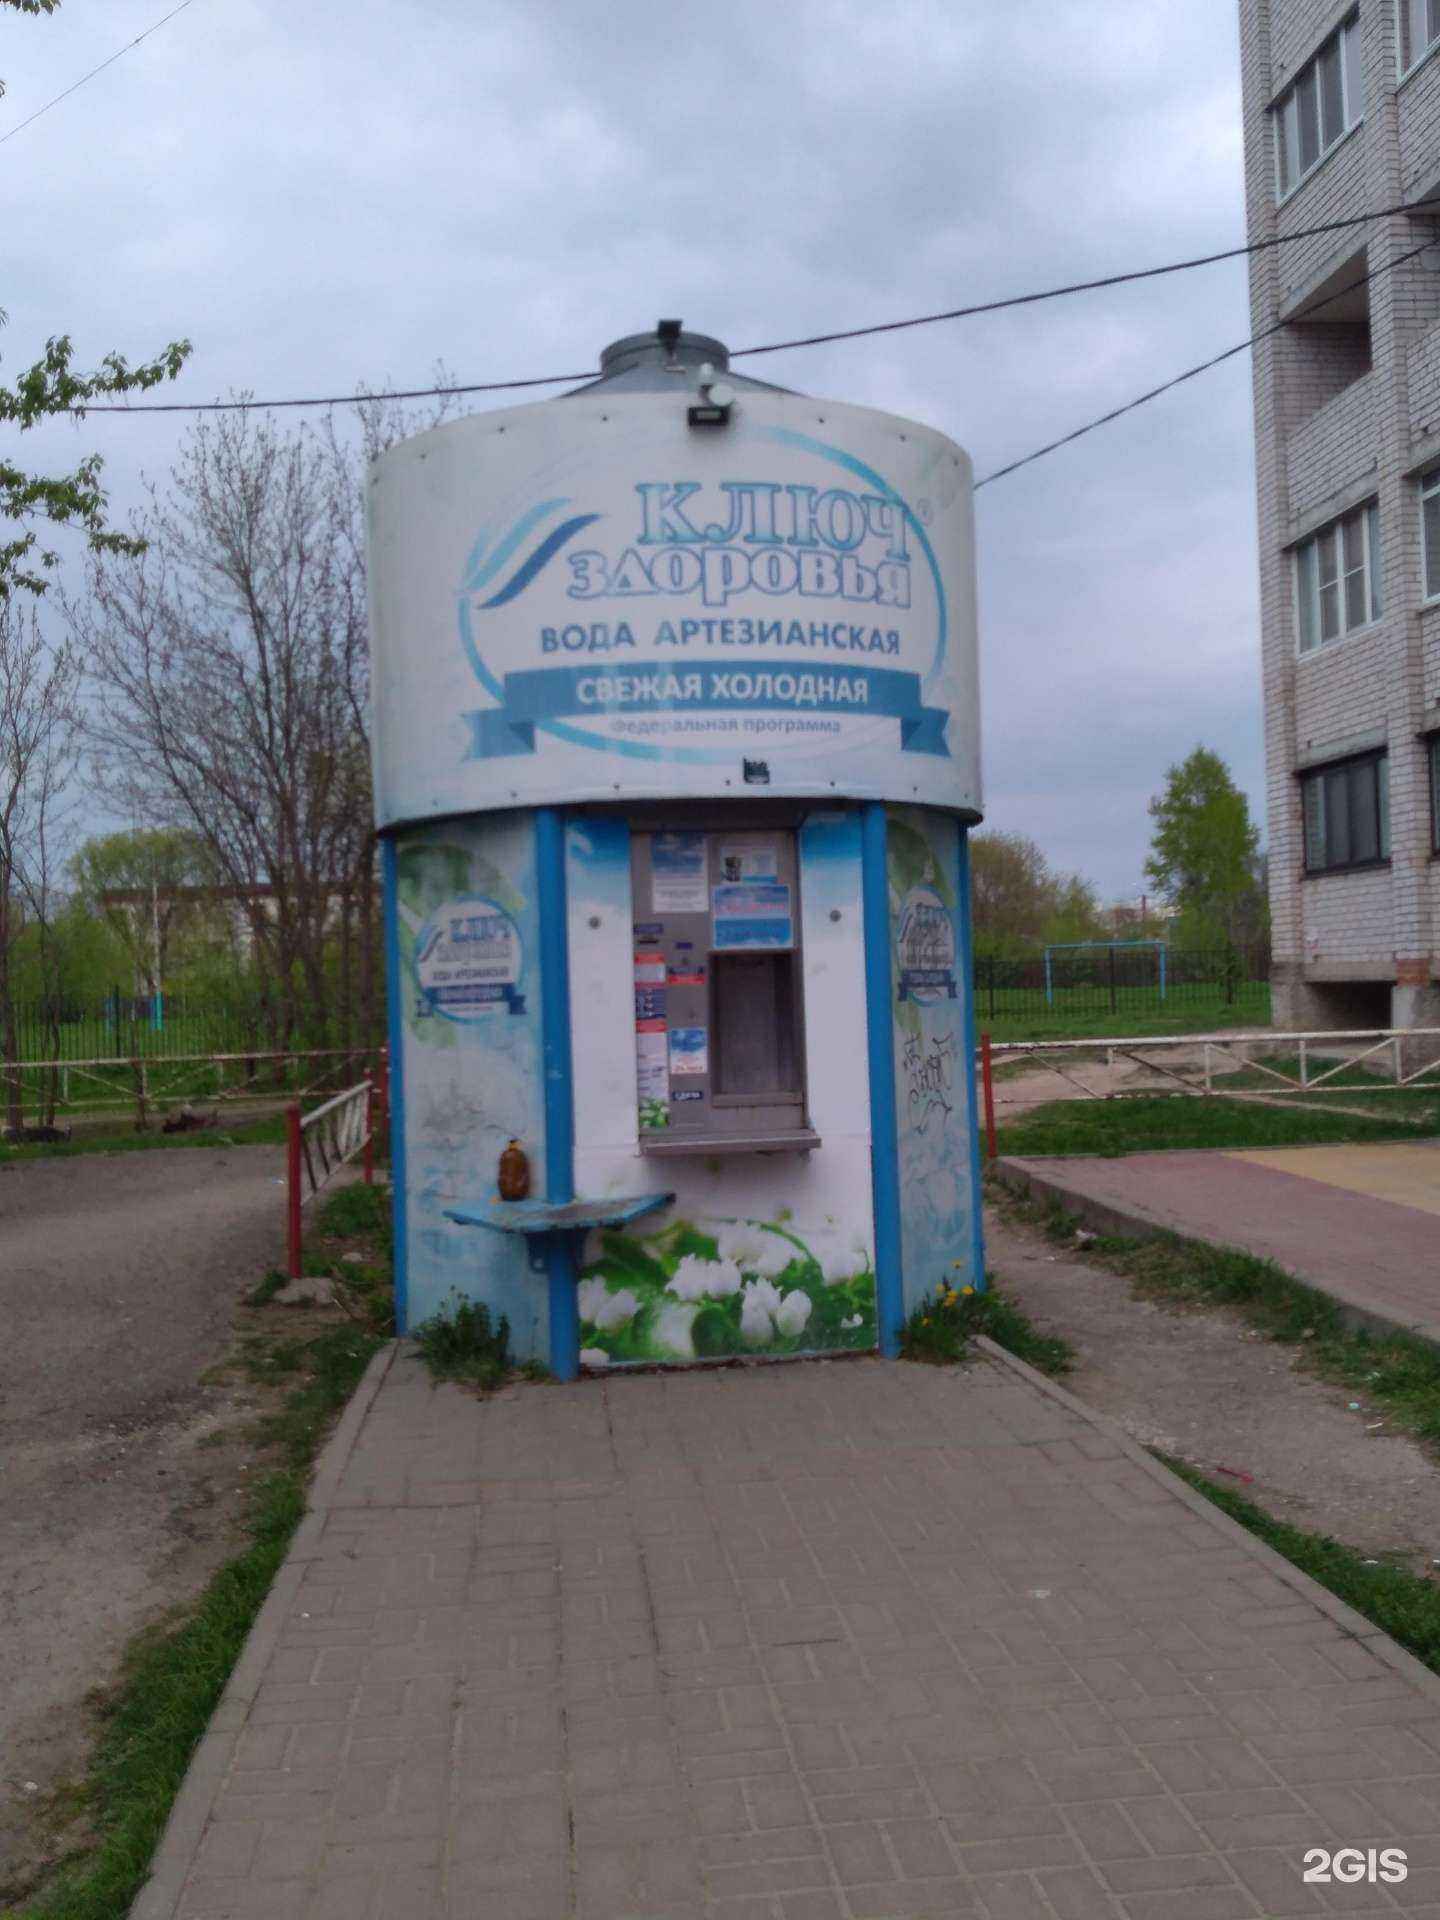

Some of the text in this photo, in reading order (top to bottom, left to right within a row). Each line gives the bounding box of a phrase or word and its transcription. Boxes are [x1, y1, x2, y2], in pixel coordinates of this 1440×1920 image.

[635, 481, 910, 562] КЛЮЧ
[541, 618, 900, 655] ВОДА АРТЕЗИАНСКАЯ
[576, 671, 869, 706] СВЕЖАЯ ХОЛОДНАЯ
[743, 717, 841, 734] программа
